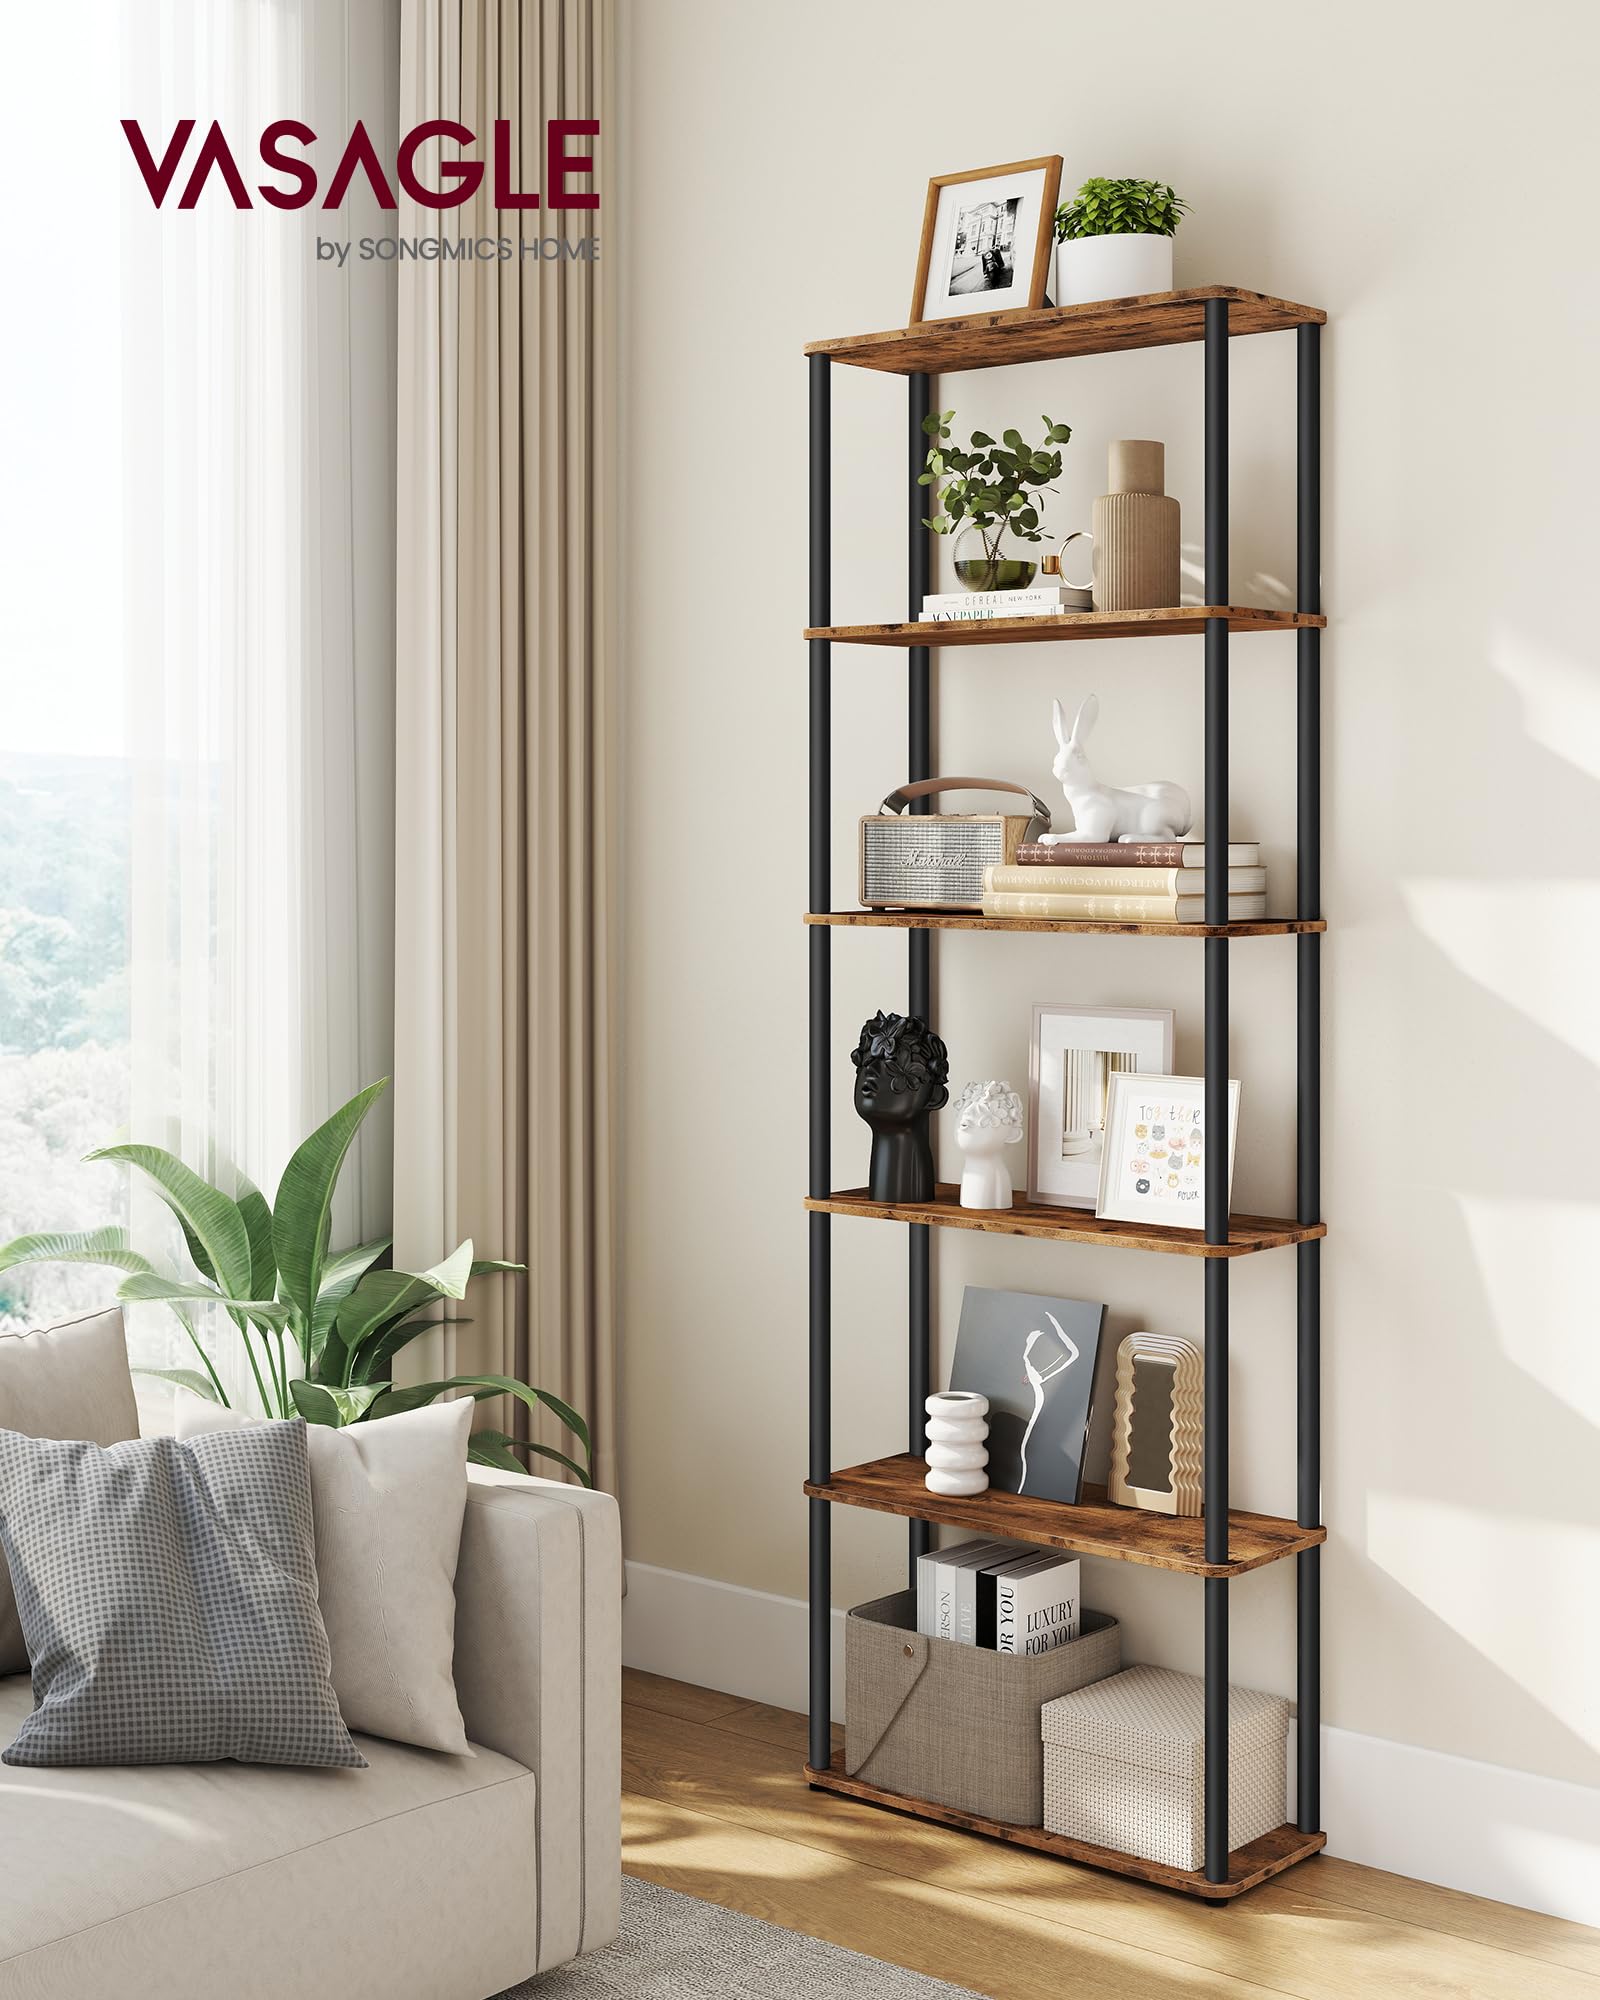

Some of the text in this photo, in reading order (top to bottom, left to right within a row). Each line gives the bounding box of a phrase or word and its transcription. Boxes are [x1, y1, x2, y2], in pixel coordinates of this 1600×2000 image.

[965, 594, 1004, 606] CEREAL
[902, 849, 967, 868] Marshall
[1000, 1585, 1014, 1625] YOU
[1026, 1598, 1074, 1633] LUXURY
[1025, 1633, 1048, 1656] FOR
